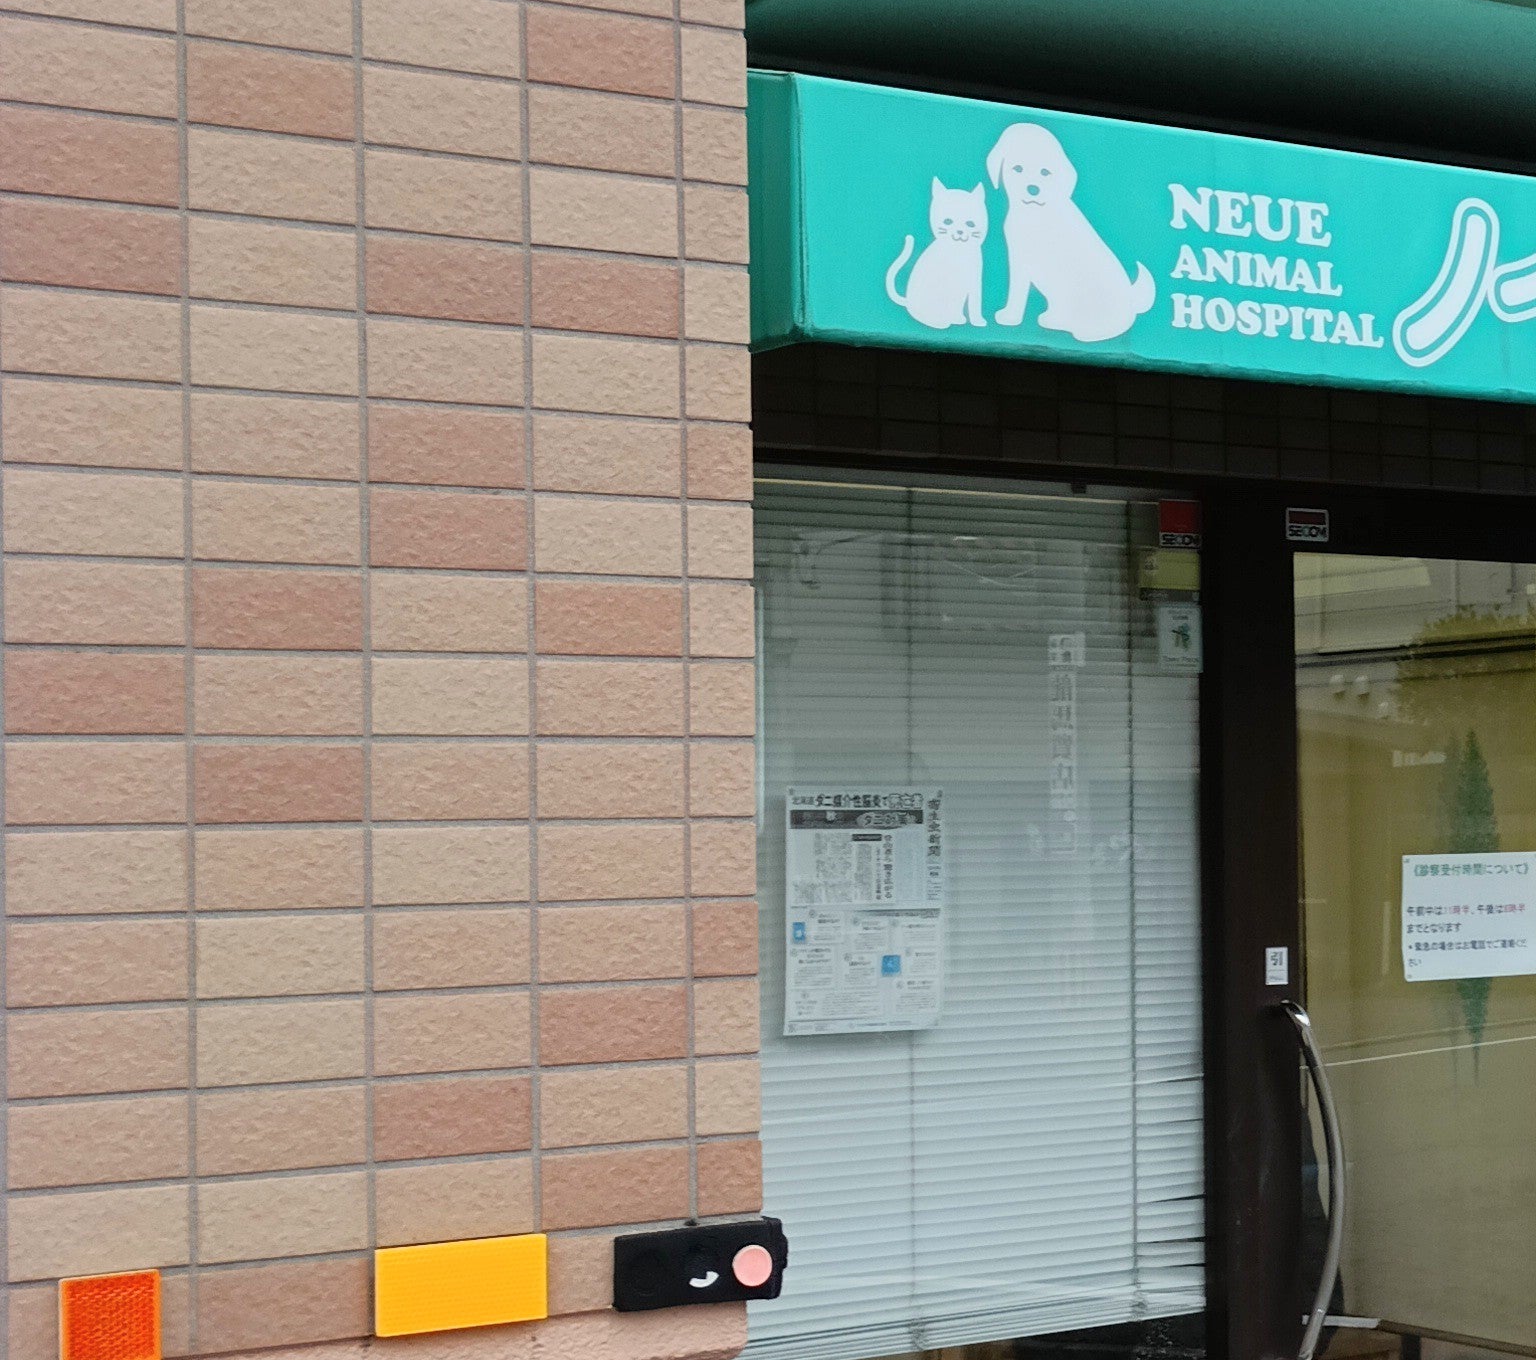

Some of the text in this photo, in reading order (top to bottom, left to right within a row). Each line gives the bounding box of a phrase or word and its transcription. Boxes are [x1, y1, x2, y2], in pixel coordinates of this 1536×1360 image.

[1167, 182, 1333, 249] NEUE
[1169, 243, 1344, 298] ANIMAL
[1171, 293, 1385, 350] HOSPITAL
